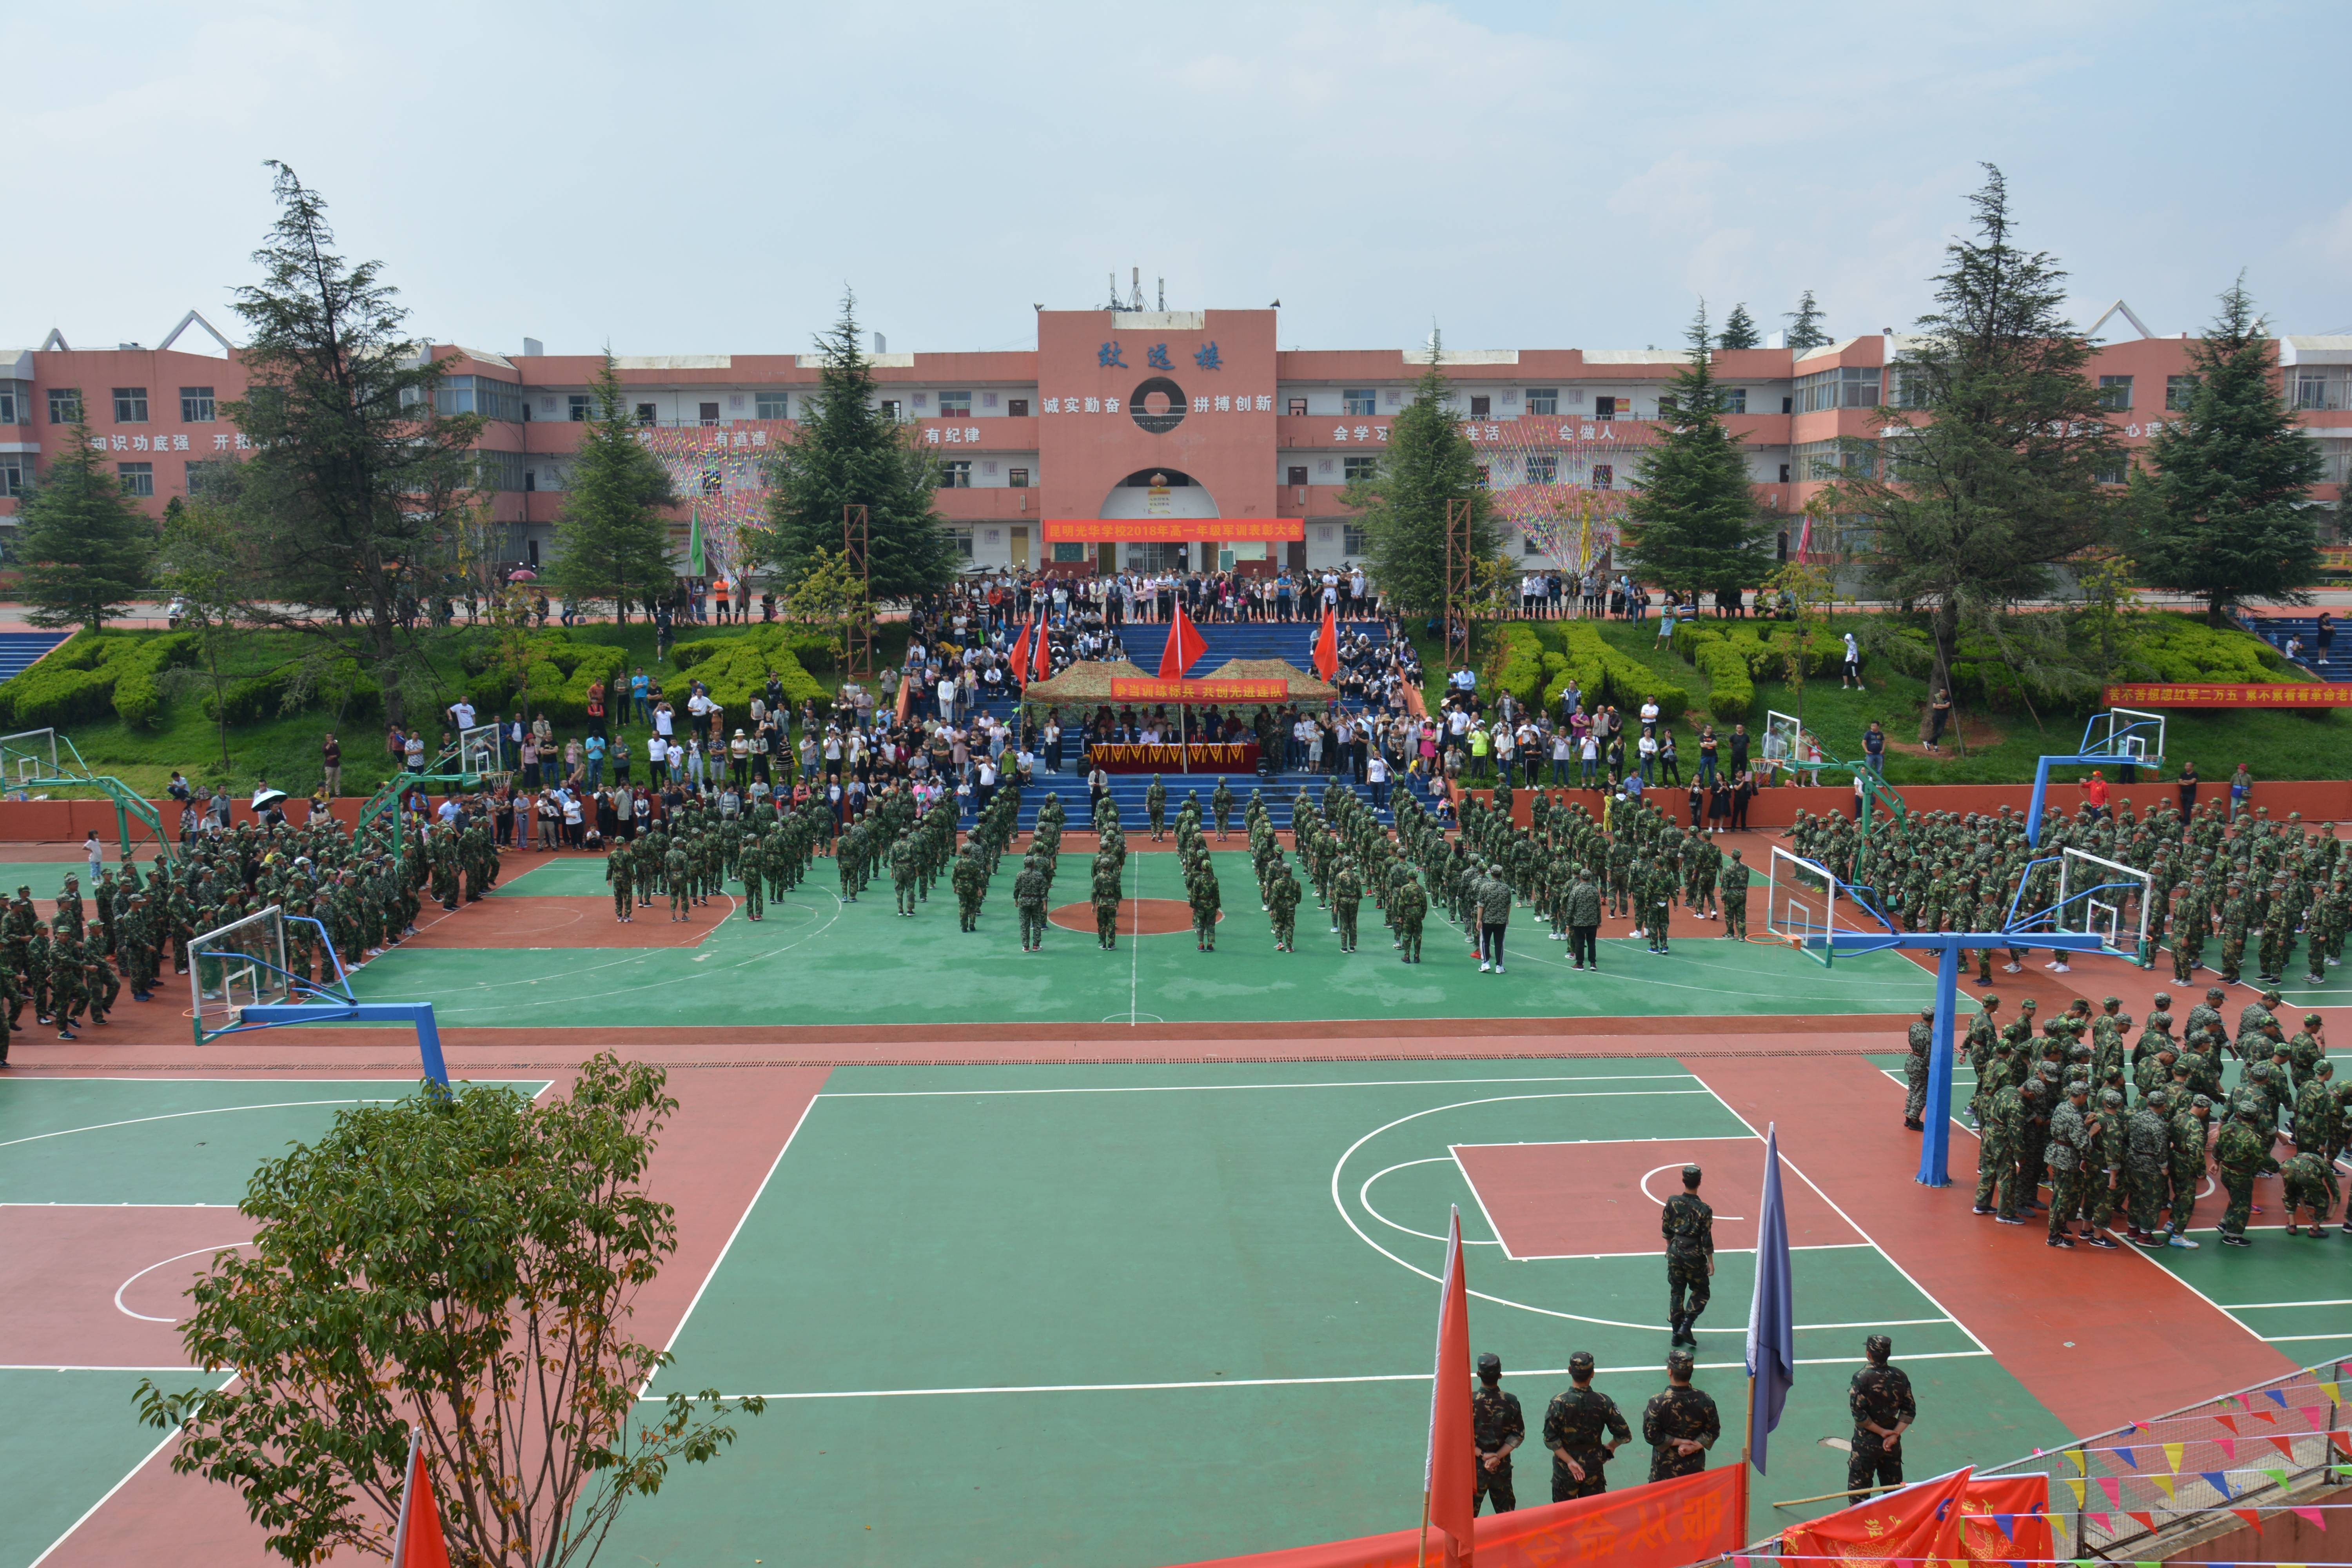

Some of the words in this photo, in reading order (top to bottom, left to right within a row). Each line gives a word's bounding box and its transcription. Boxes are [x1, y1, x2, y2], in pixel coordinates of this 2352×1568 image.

[1098, 341, 1223, 370] 致远楼
[1043, 396, 1120, 414] 诚实勤奋
[1193, 395, 1272, 413] 拼搏创新
[715, 430, 767, 447] 有道德
[925, 427, 980, 444] 有纪律
[1454, 425, 1500, 441] 生活
[1558, 425, 1615, 441] 会做人
[91, 434, 190, 452] 知识功底强
[1050, 523, 1300, 537] 昆明光华学校2018年高一年级军训表彰大会
[1114, 683, 1195, 698] 争当训练标兵
[1202, 684, 1283, 698] 共创先进连队
[2109, 688, 2238, 701] 苦不苦想想红军二万五
